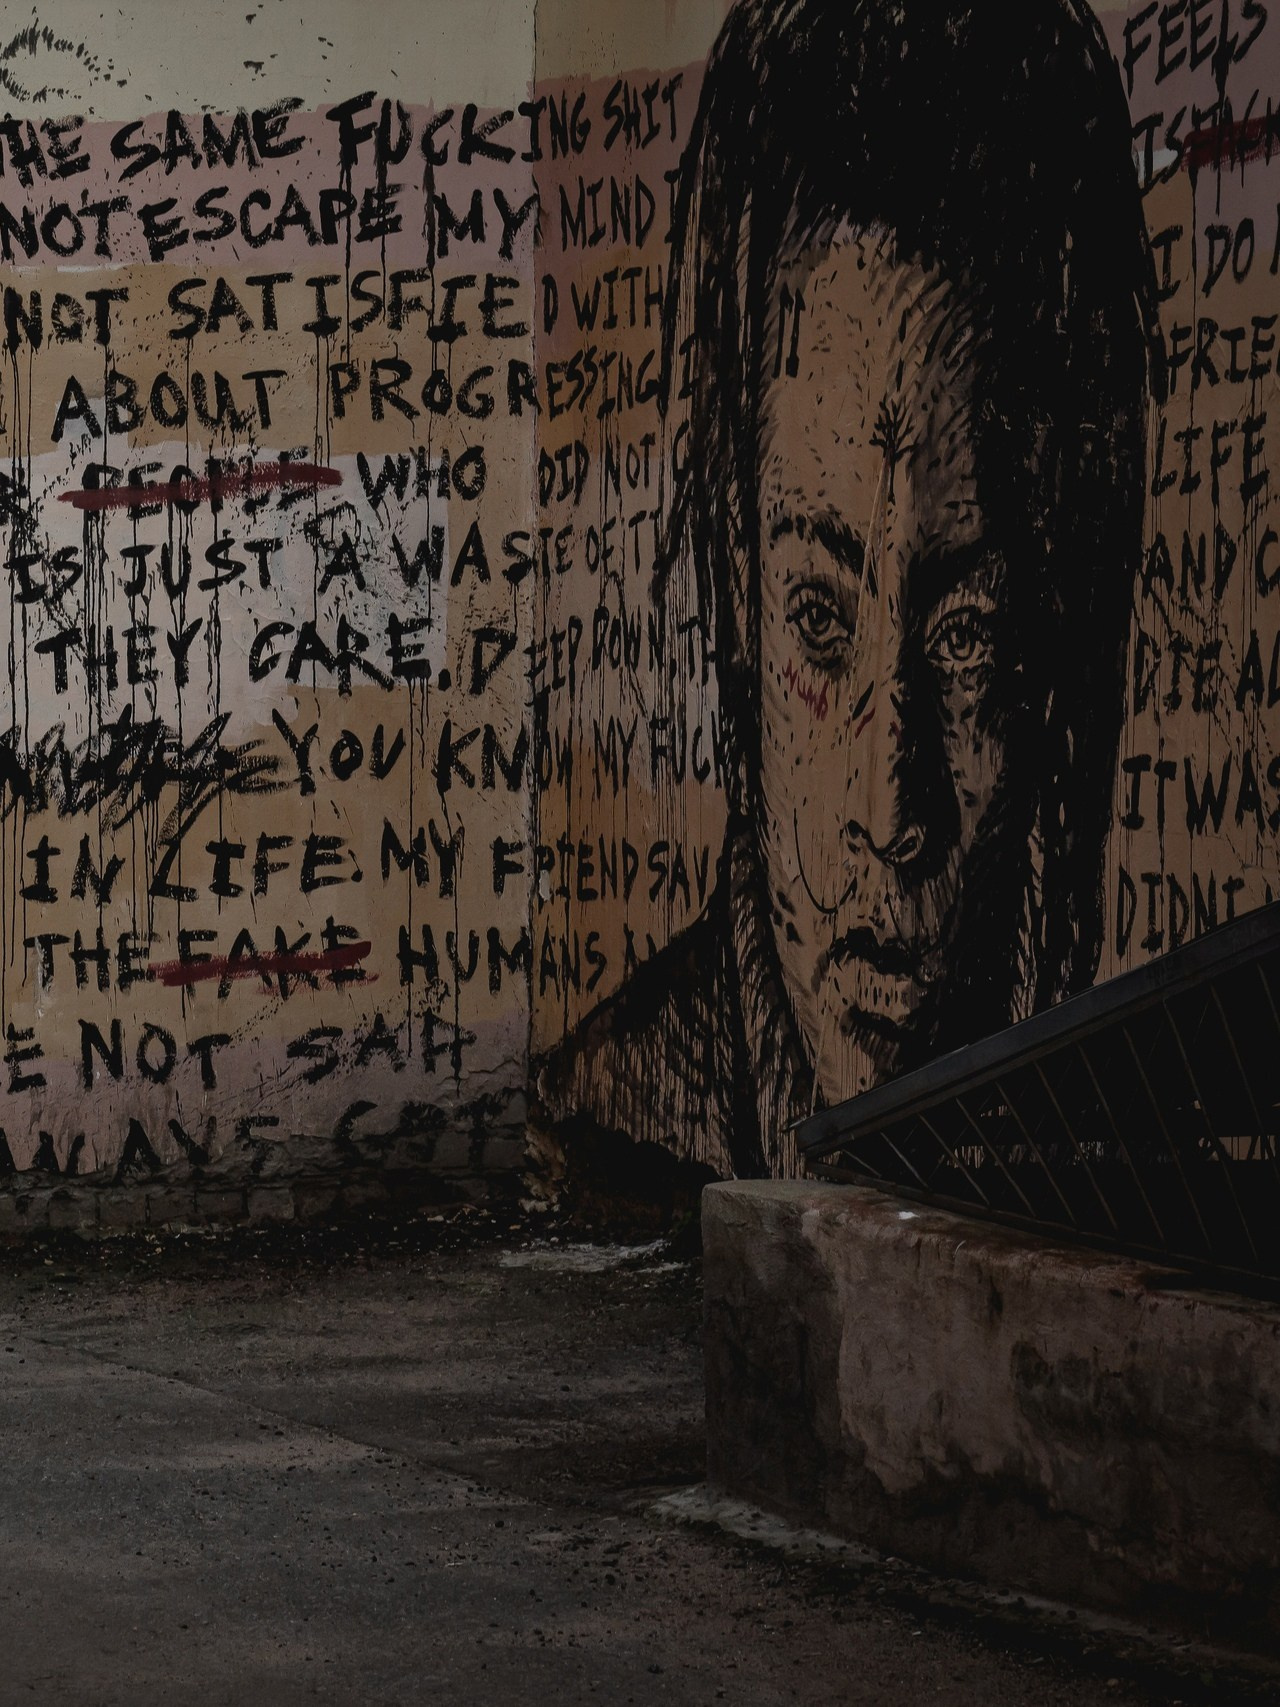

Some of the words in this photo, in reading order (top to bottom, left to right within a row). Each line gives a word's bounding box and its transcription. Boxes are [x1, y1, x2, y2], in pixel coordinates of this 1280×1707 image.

[110, 98, 307, 181] SAME
[326, 91, 592, 166] FUCKING
[603, 73, 683, 152] SHIT
[137, 185, 417, 262] ESCAPE
[434, 188, 540, 262] MY
[559, 173, 655, 252] MIND
[1149, 224, 1183, 302] I
[1202, 217, 1254, 298] DO
[4, 286, 129, 352] NOT
[571, 264, 663, 331] WITH
[51, 369, 288, 443] ABOUT
[329, 346, 663, 421] PROGRESSING
[1166, 314, 1280, 395] FRIE
[356, 445, 487, 509] WHO
[538, 439, 590, 508] DID
[605, 432, 655, 498] NOT
[1151, 412, 1269, 505] LIFE
[3, 546, 83, 603] IS
[120, 536, 284, 598] JUST
[319, 531, 366, 594] A
[392, 520, 573, 588] WASTE
[586, 517, 616, 576] OF
[1142, 521, 1237, 600] AND
[34, 616, 203, 695] THEY
[272, 707, 407, 796] YOU
[593, 714, 638, 800] MY
[1122, 754, 1177, 835] IT
[19, 833, 126, 908] IN
[381, 817, 466, 899] MY
[22, 926, 160, 993] THE
[178, 915, 368, 999] FAKE
[397, 915, 607, 1001] HUMANS
[78, 1017, 231, 1091] NOT
